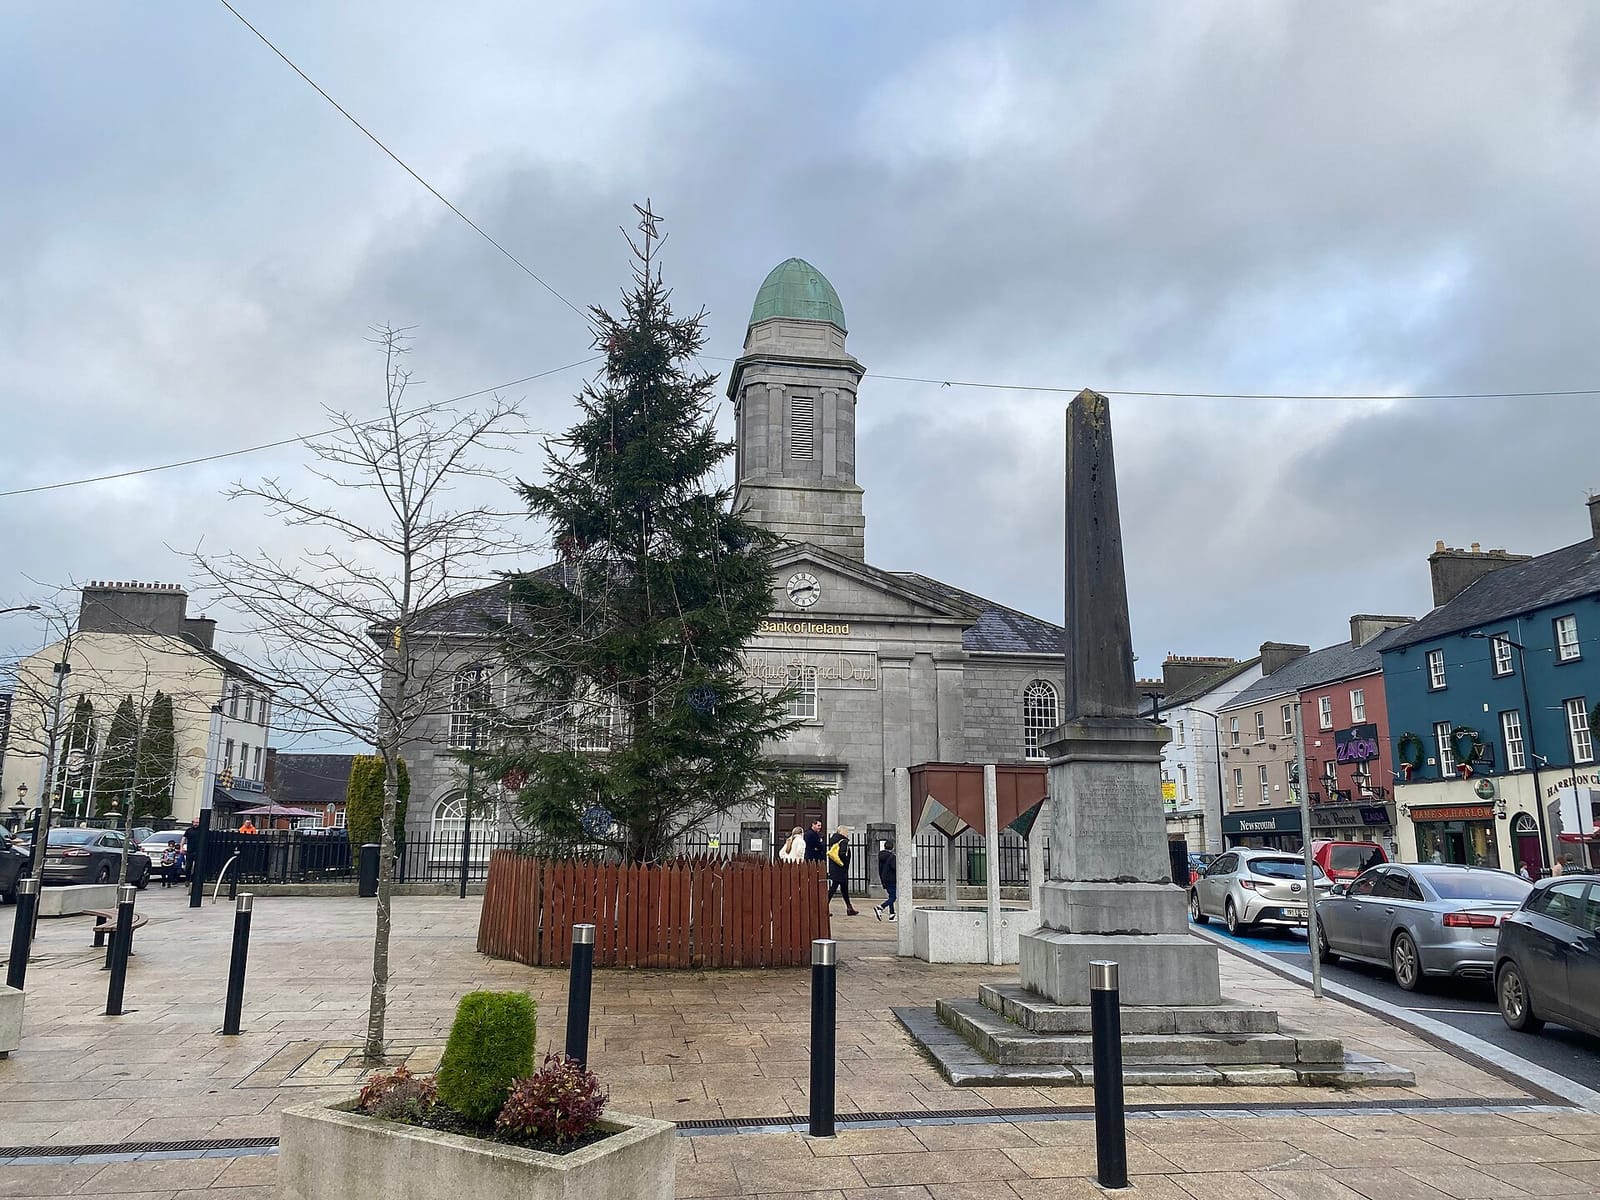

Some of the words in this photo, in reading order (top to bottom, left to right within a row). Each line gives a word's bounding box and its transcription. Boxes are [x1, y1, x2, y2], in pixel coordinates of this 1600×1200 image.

[761, 620, 792, 633] Bank
[793, 622, 806, 633] of
[807, 622, 849, 634] Ireland
[1415, 811, 1443, 819] JAMES
[1239, 817, 1276, 831] Newsround
